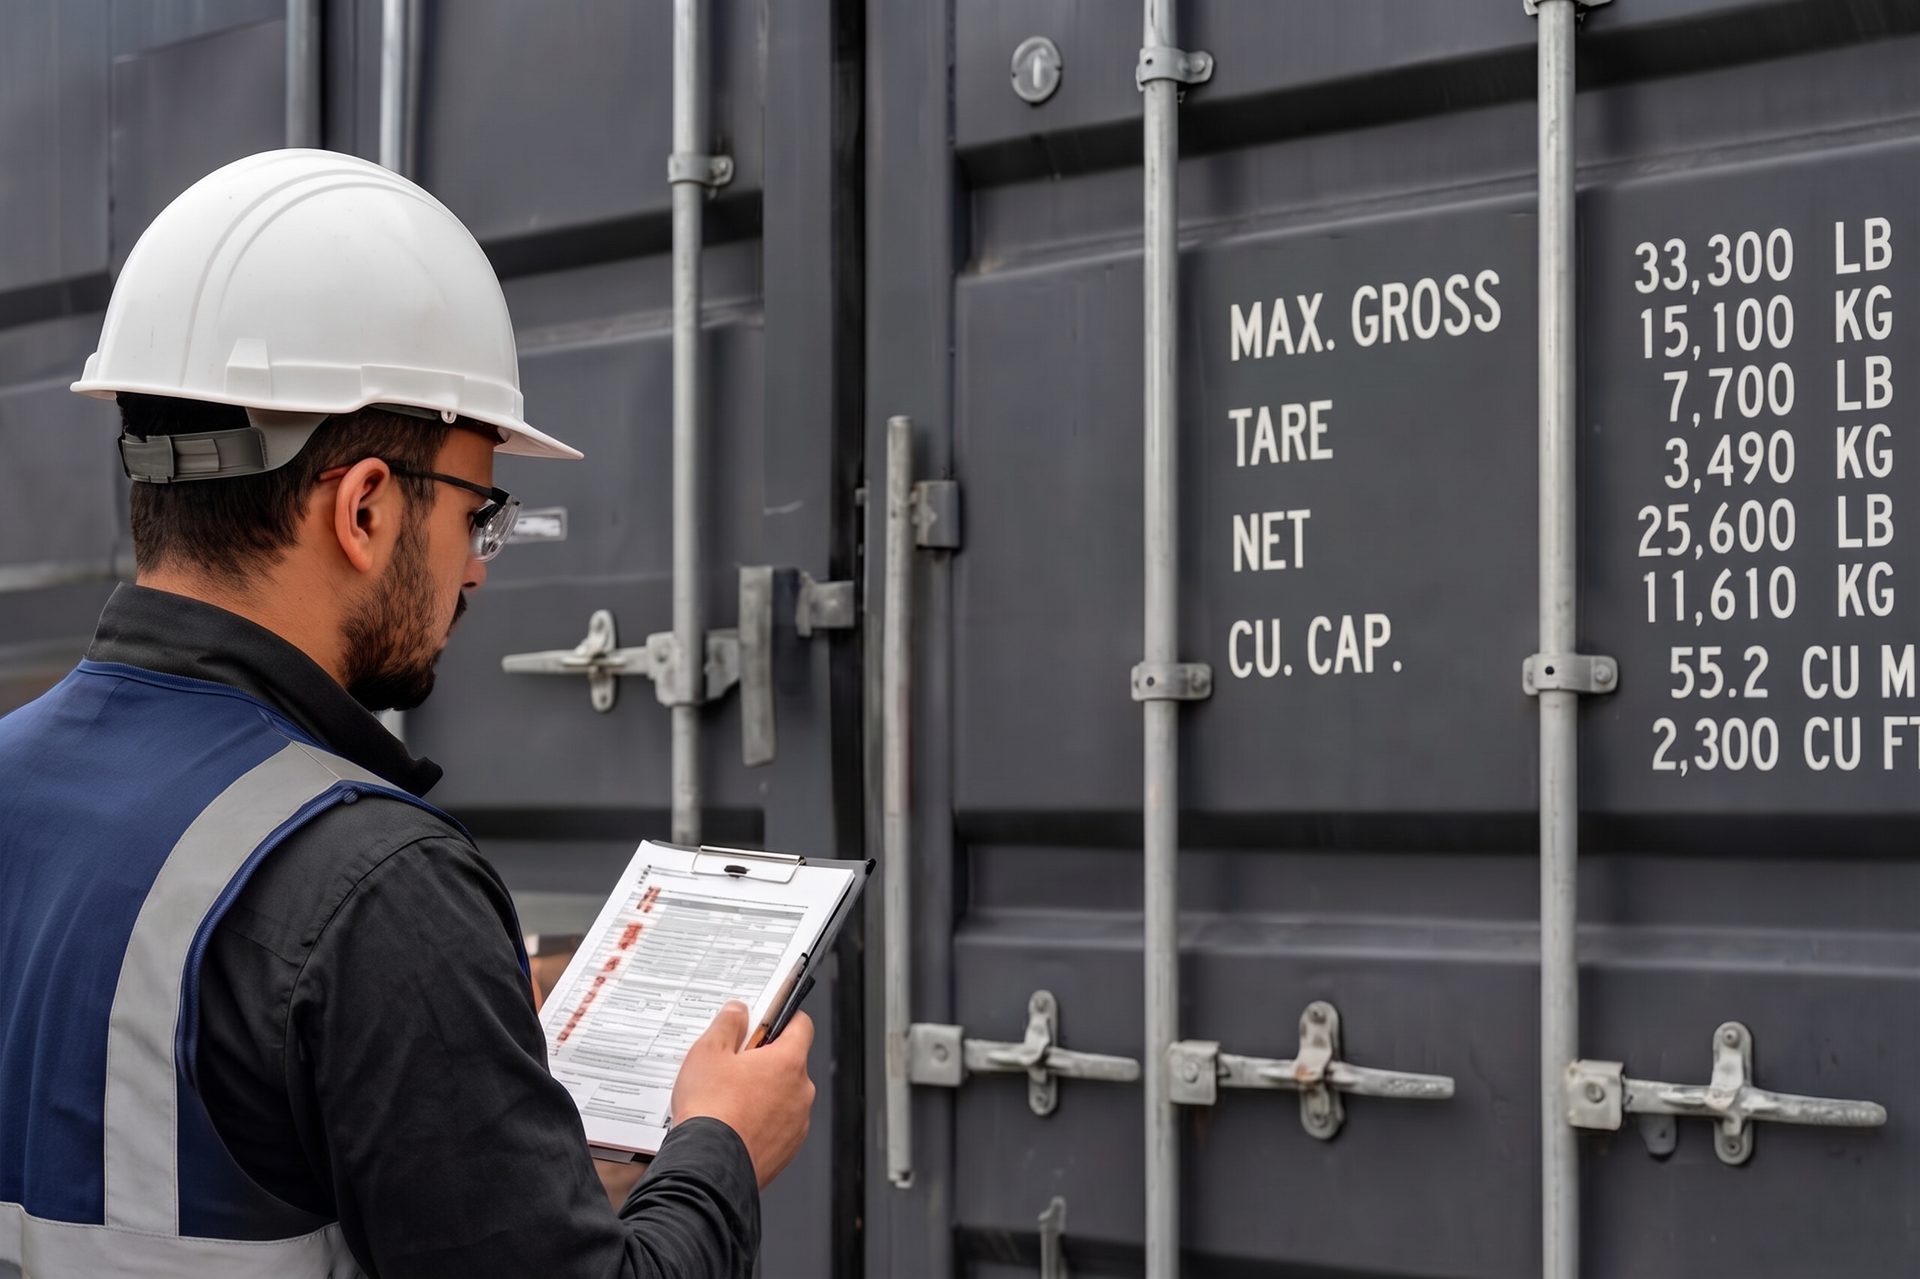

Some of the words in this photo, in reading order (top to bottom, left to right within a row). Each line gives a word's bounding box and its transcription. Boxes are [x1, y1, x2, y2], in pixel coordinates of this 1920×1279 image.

[1634, 227, 1794, 296] 33,300
[1835, 216, 1893, 275] LB
[1230, 292, 1336, 362] MAX.
[1351, 269, 1502, 347] GROSS
[1640, 294, 1794, 361] 15,100
[1835, 284, 1893, 344] KG
[1663, 361, 1795, 428] 7,700
[1836, 355, 1894, 412] LB
[1228, 399, 1334, 468] TARE
[1664, 429, 1795, 494] 3,490
[1836, 423, 1893, 480] KG
[1233, 508, 1311, 572] NET
[1637, 498, 1796, 560] 25,600
[1837, 493, 1894, 549] LB
[1643, 565, 1796, 627] 11,610
[1837, 561, 1895, 618] KG
[1228, 618, 1293, 679] CU.
[1307, 613, 1402, 675] CAP.
[1670, 645, 1769, 699] 55.2
[1801, 645, 1860, 700] CU
[1881, 644, 1916, 698] M
[1652, 717, 1779, 777] 2,300
[1803, 716, 1861, 771] CU
